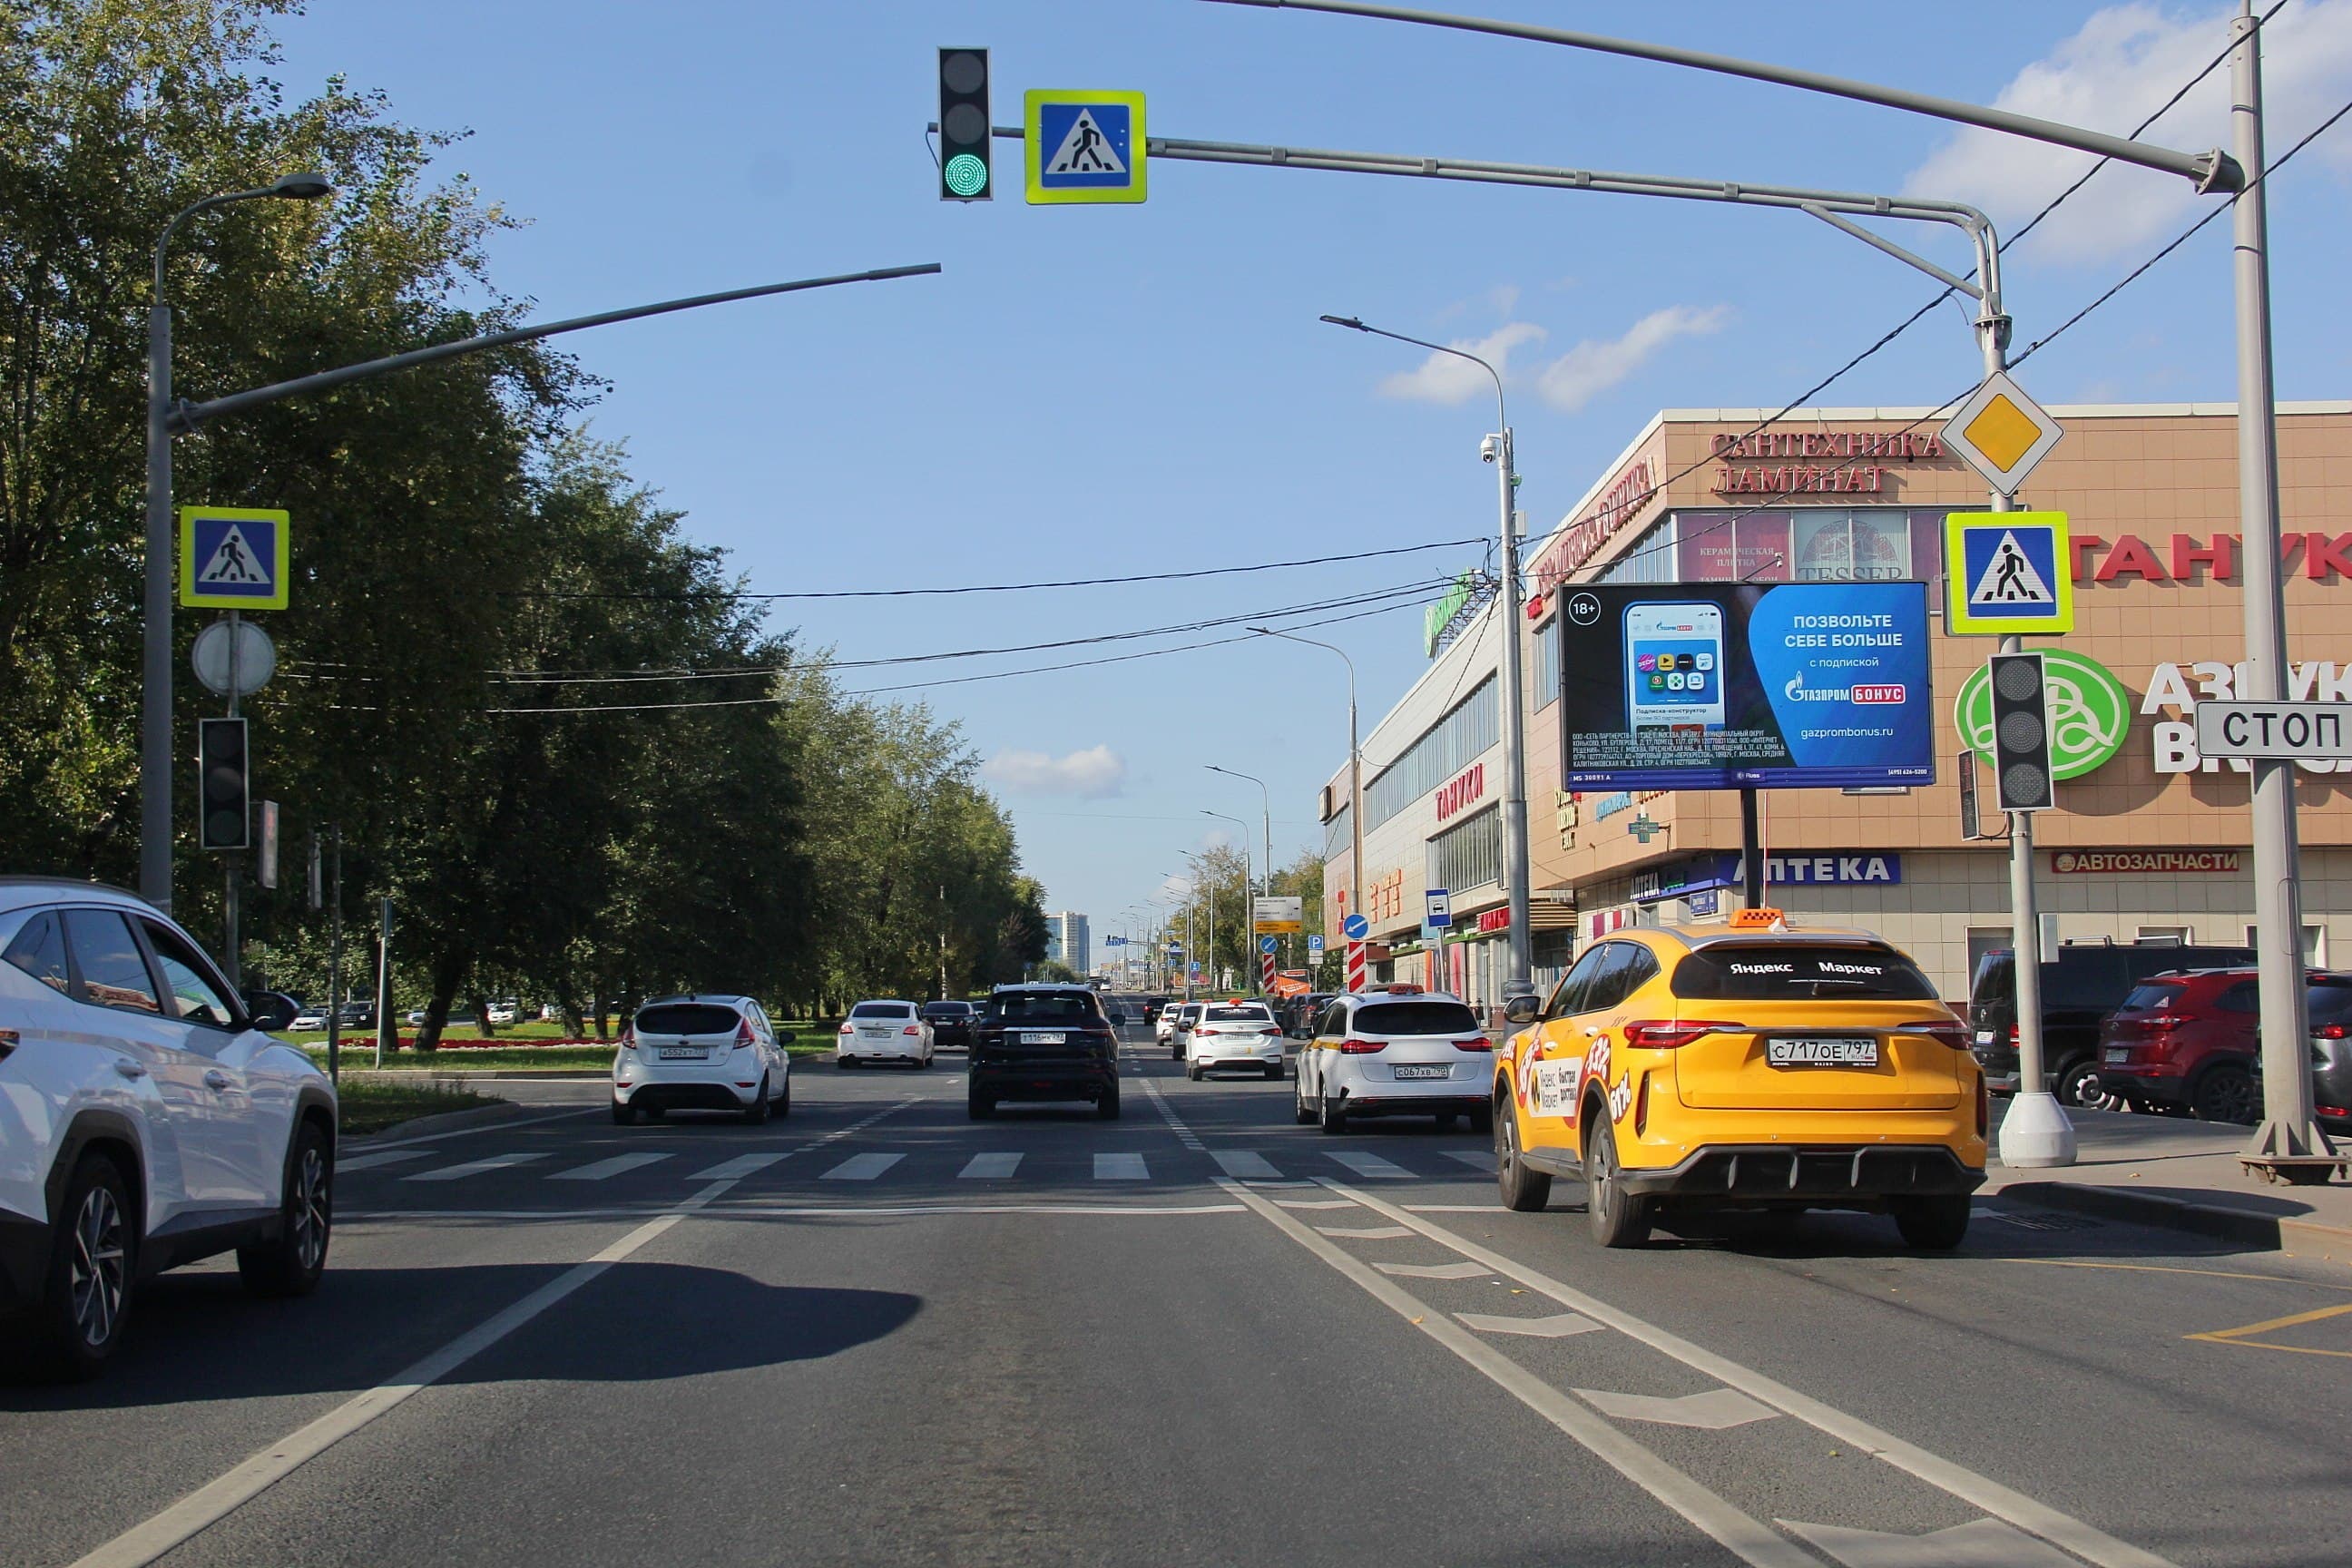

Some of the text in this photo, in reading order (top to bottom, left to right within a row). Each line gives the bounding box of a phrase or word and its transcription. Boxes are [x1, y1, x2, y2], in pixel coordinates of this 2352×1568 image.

[1710, 432, 1946, 456] САНТЕХНИКА
[1710, 466, 1886, 494] ЛАМИНАТ
[1700, 547, 1774, 555] КЕРАМЧЕСКАЯ
[1573, 603, 1595, 614] 18+
[1794, 614, 1892, 628] ПОЗВОЛЬТЕ
[1785, 633, 1903, 647] СЕБЕ БОЛЬШЕ
[1819, 656, 1879, 668] подпиской
[1804, 688, 1902, 701] ГАЗПРОМ БОНУС
[1800, 728, 1894, 740] gazprombonus.ru
[2223, 711, 2341, 747] СТОП
[1436, 763, 1483, 822] ТАНУКИ
[2076, 854, 2239, 870] АВТОЗАПЧАСТИ
[1730, 962, 1883, 975] Яндекс Маркет
[1775, 1041, 1870, 1059] С717ОЕ 797
